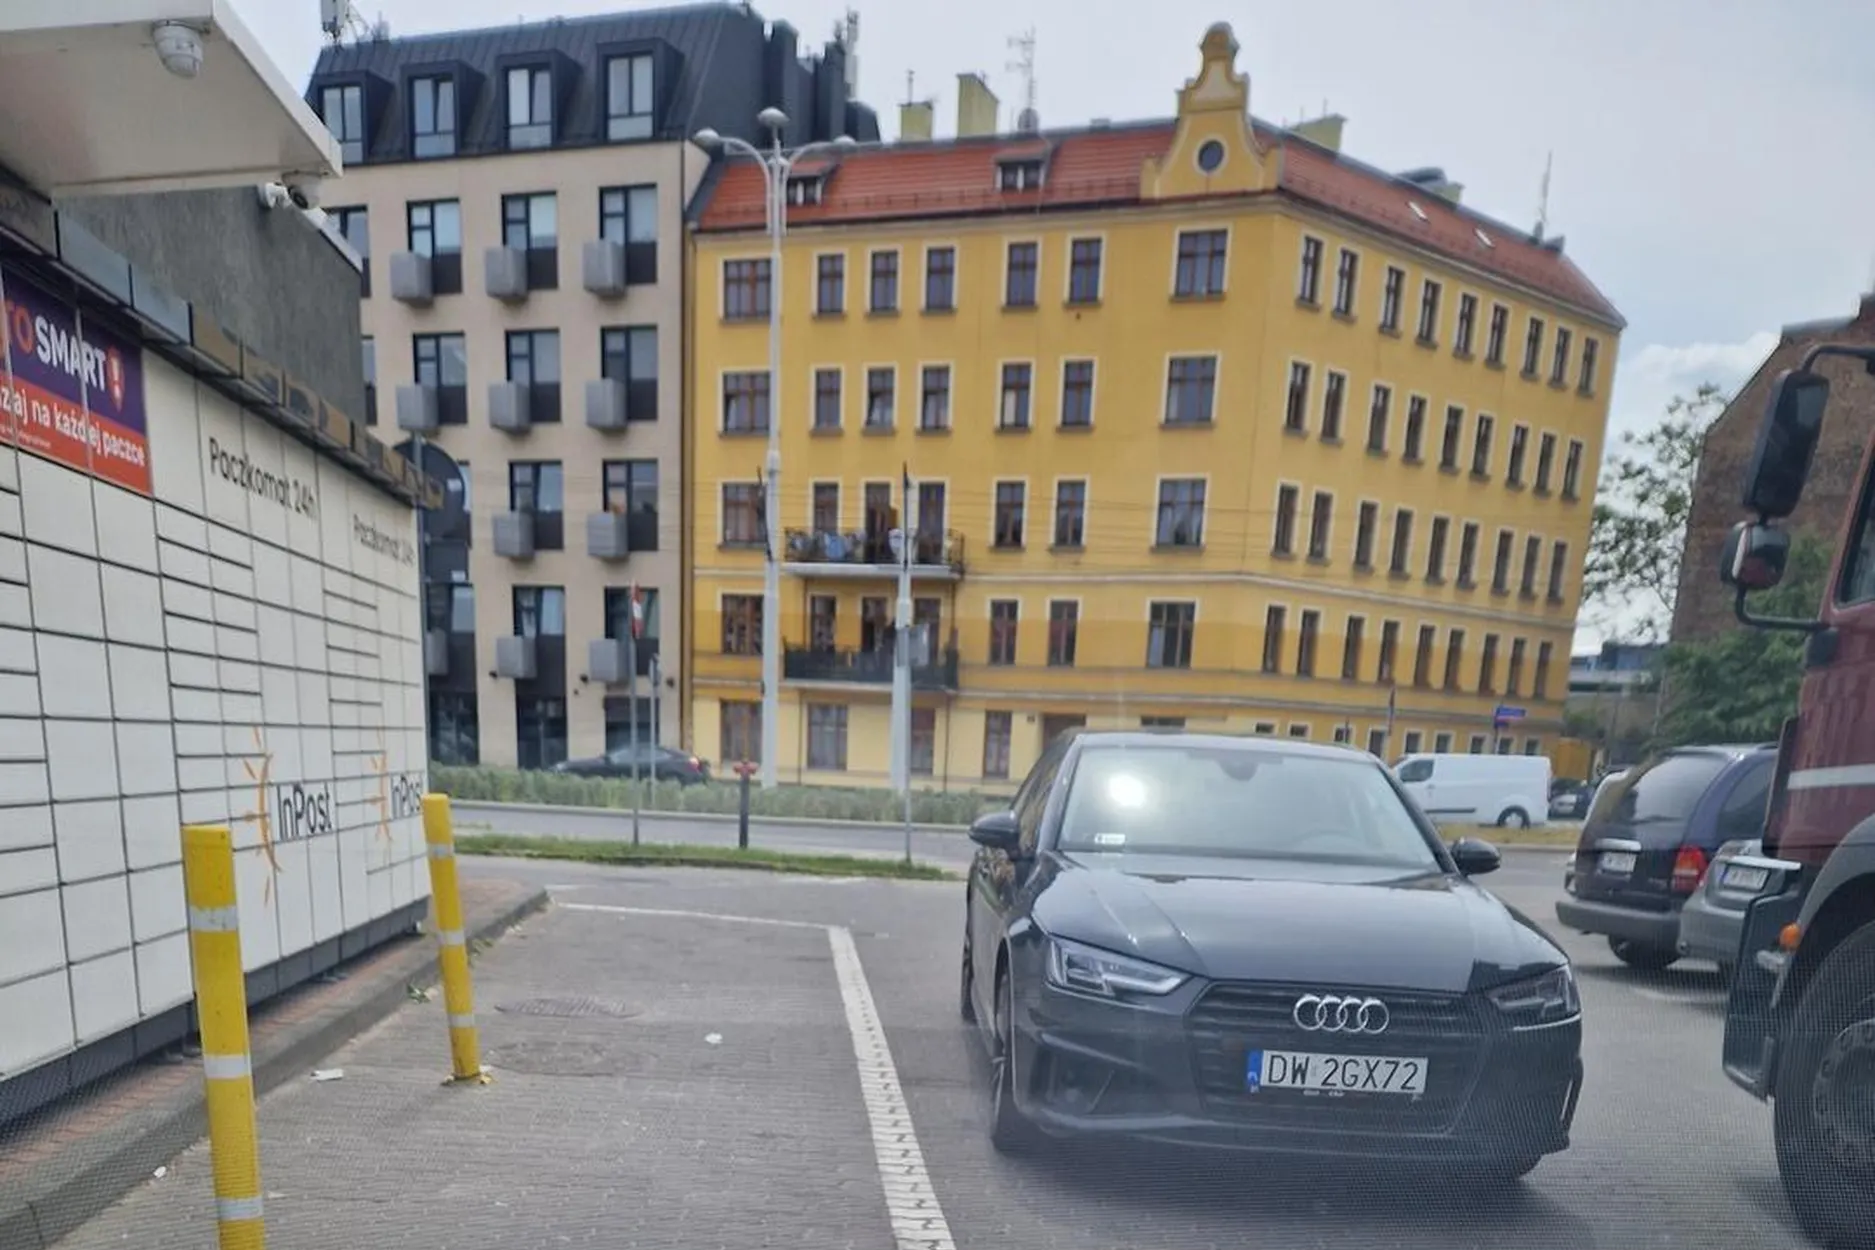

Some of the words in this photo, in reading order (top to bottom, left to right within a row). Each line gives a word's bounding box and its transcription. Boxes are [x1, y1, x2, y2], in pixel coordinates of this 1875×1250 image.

[31, 399, 50, 428] na
[53, 402, 101, 456] każdej
[209, 437, 292, 508] Paczkomat
[277, 782, 332, 840] InPost
[1267, 1054, 1310, 1085] DW
[1321, 1058, 1419, 1091] 2GX72
